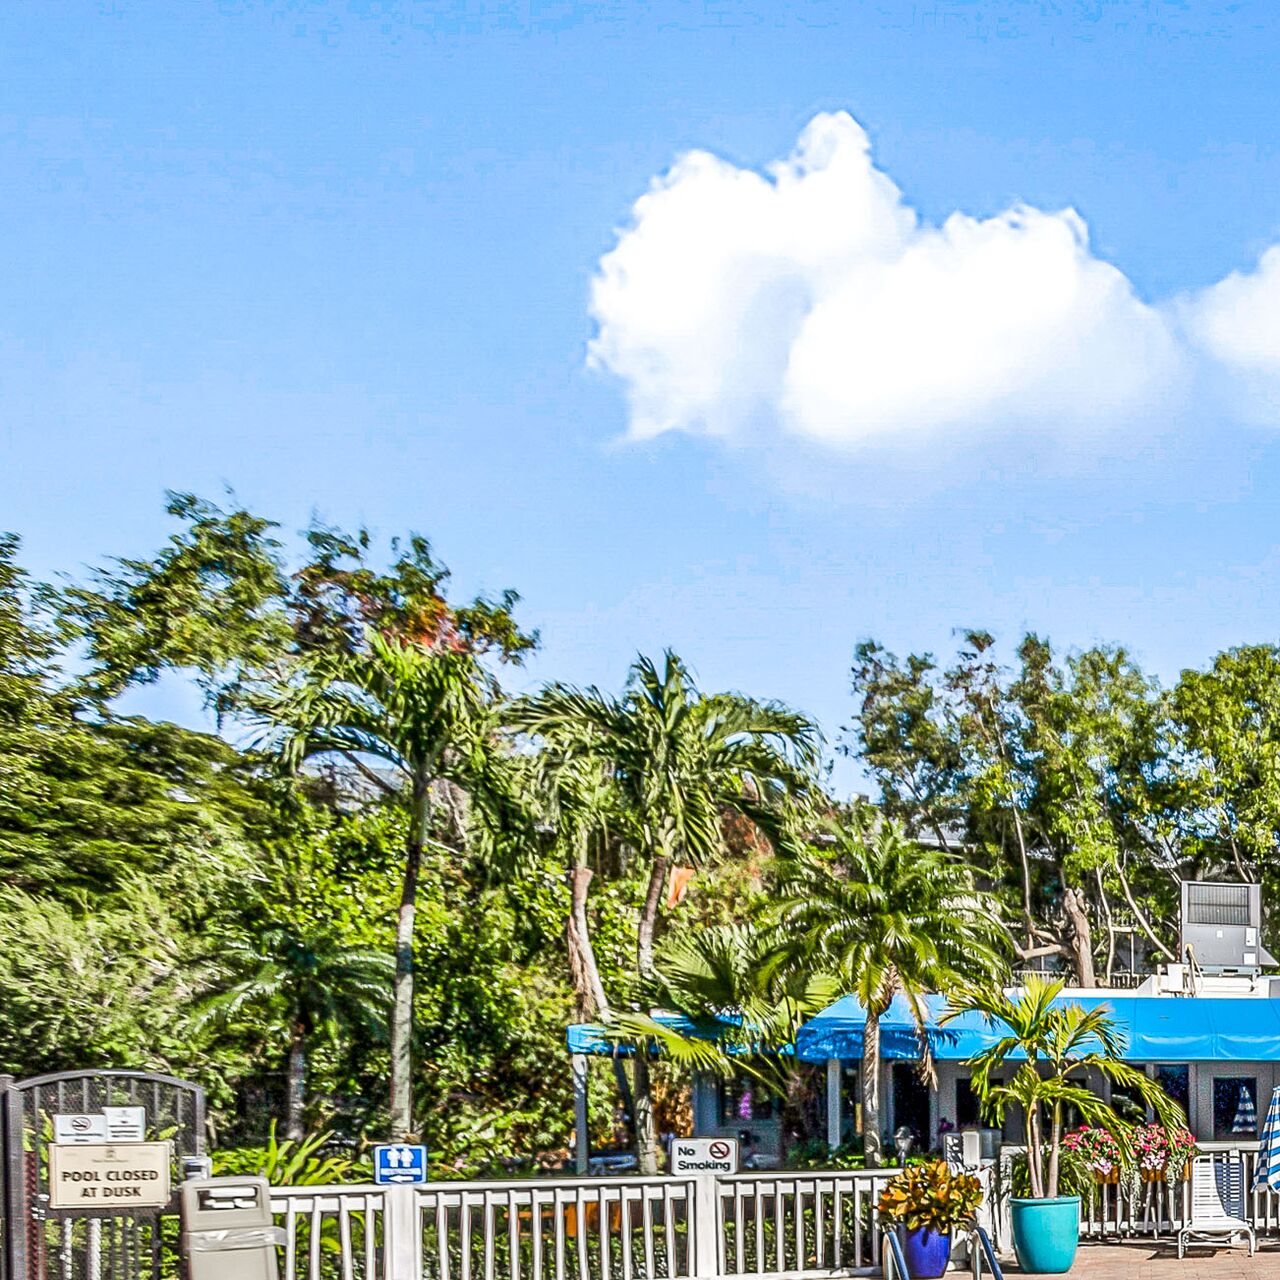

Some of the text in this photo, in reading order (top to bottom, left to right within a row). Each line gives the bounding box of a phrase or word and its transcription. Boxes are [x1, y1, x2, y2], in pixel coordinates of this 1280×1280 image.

[678, 1147, 695, 1156] No
[678, 1160, 731, 1171] Smoking
[62, 1170, 159, 1182] POOL CLOSED
[81, 1187, 141, 1198] AT DUSK
